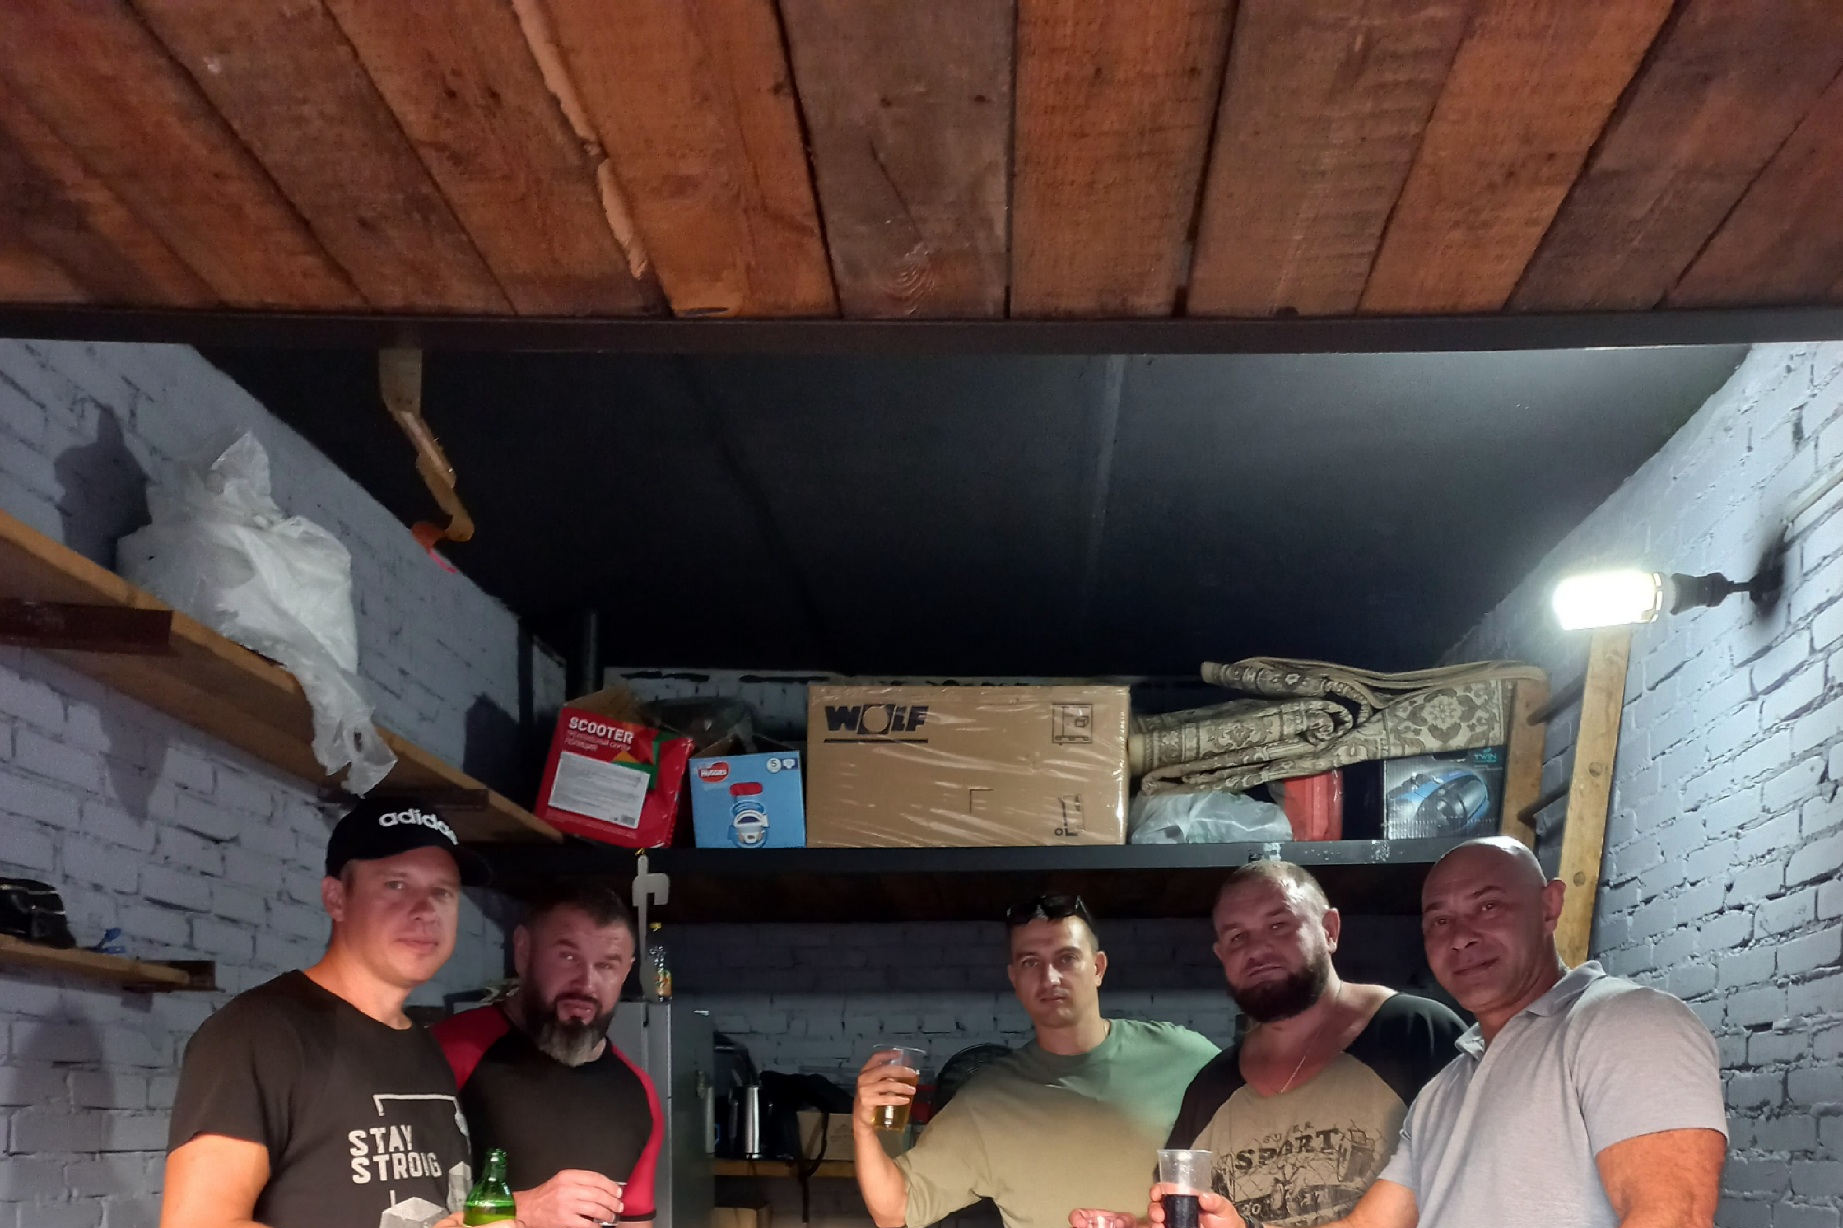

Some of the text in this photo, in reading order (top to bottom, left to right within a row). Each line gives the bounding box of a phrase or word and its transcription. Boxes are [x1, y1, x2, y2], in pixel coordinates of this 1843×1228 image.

[569, 716, 634, 744] SCOOTER
[824, 703, 929, 734] WOLF
[770, 760, 778, 768] 5
[378, 807, 459, 846] adidas
[347, 1124, 413, 1157] STAY
